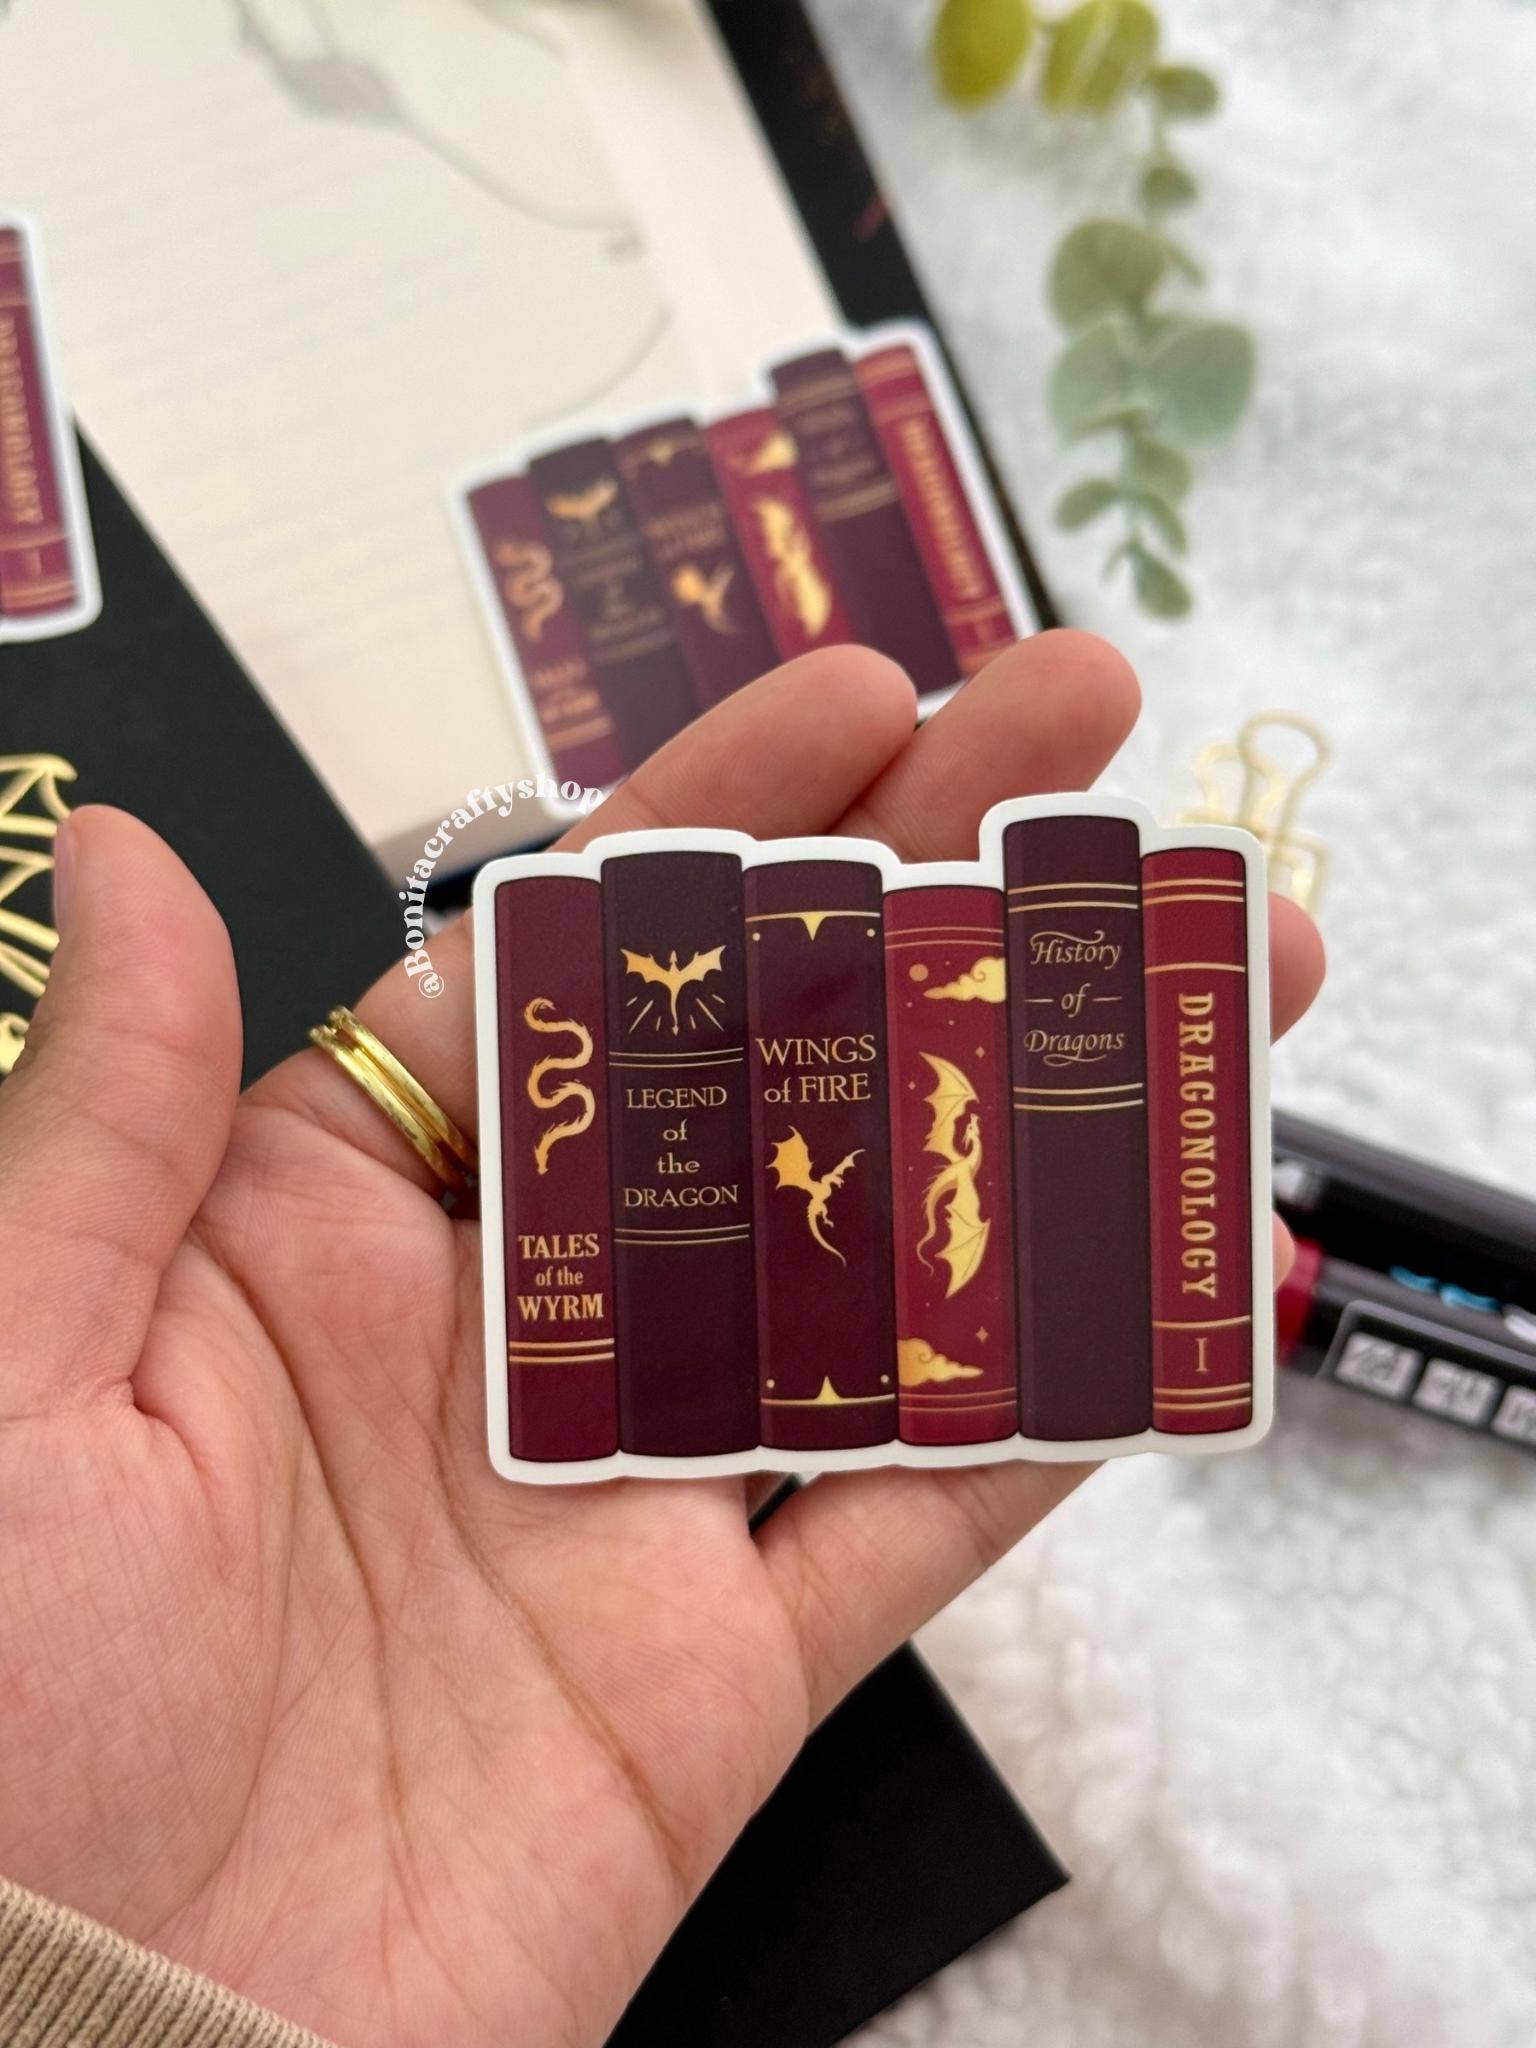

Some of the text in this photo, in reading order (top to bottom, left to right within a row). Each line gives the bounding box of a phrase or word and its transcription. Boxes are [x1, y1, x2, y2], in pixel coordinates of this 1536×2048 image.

[1030, 931, 1121, 970] History
[1060, 982, 1091, 1018] of
[756, 1035, 876, 1066] WINGS
[1024, 1030, 1125, 1067] Dragons
[626, 1086, 728, 1109] LEGEND
[763, 1073, 871, 1103] of FIRE
[662, 1119, 688, 1142] of
[1178, 992, 1217, 1298] DRAGONOLOGY
[657, 1152, 701, 1174] the
[623, 1184, 739, 1208] DRAGON
[518, 1234, 600, 1260] TALES
[536, 1267, 584, 1287] of the
[517, 1293, 604, 1322] WYRM
[1194, 1337, 1210, 1373] I
